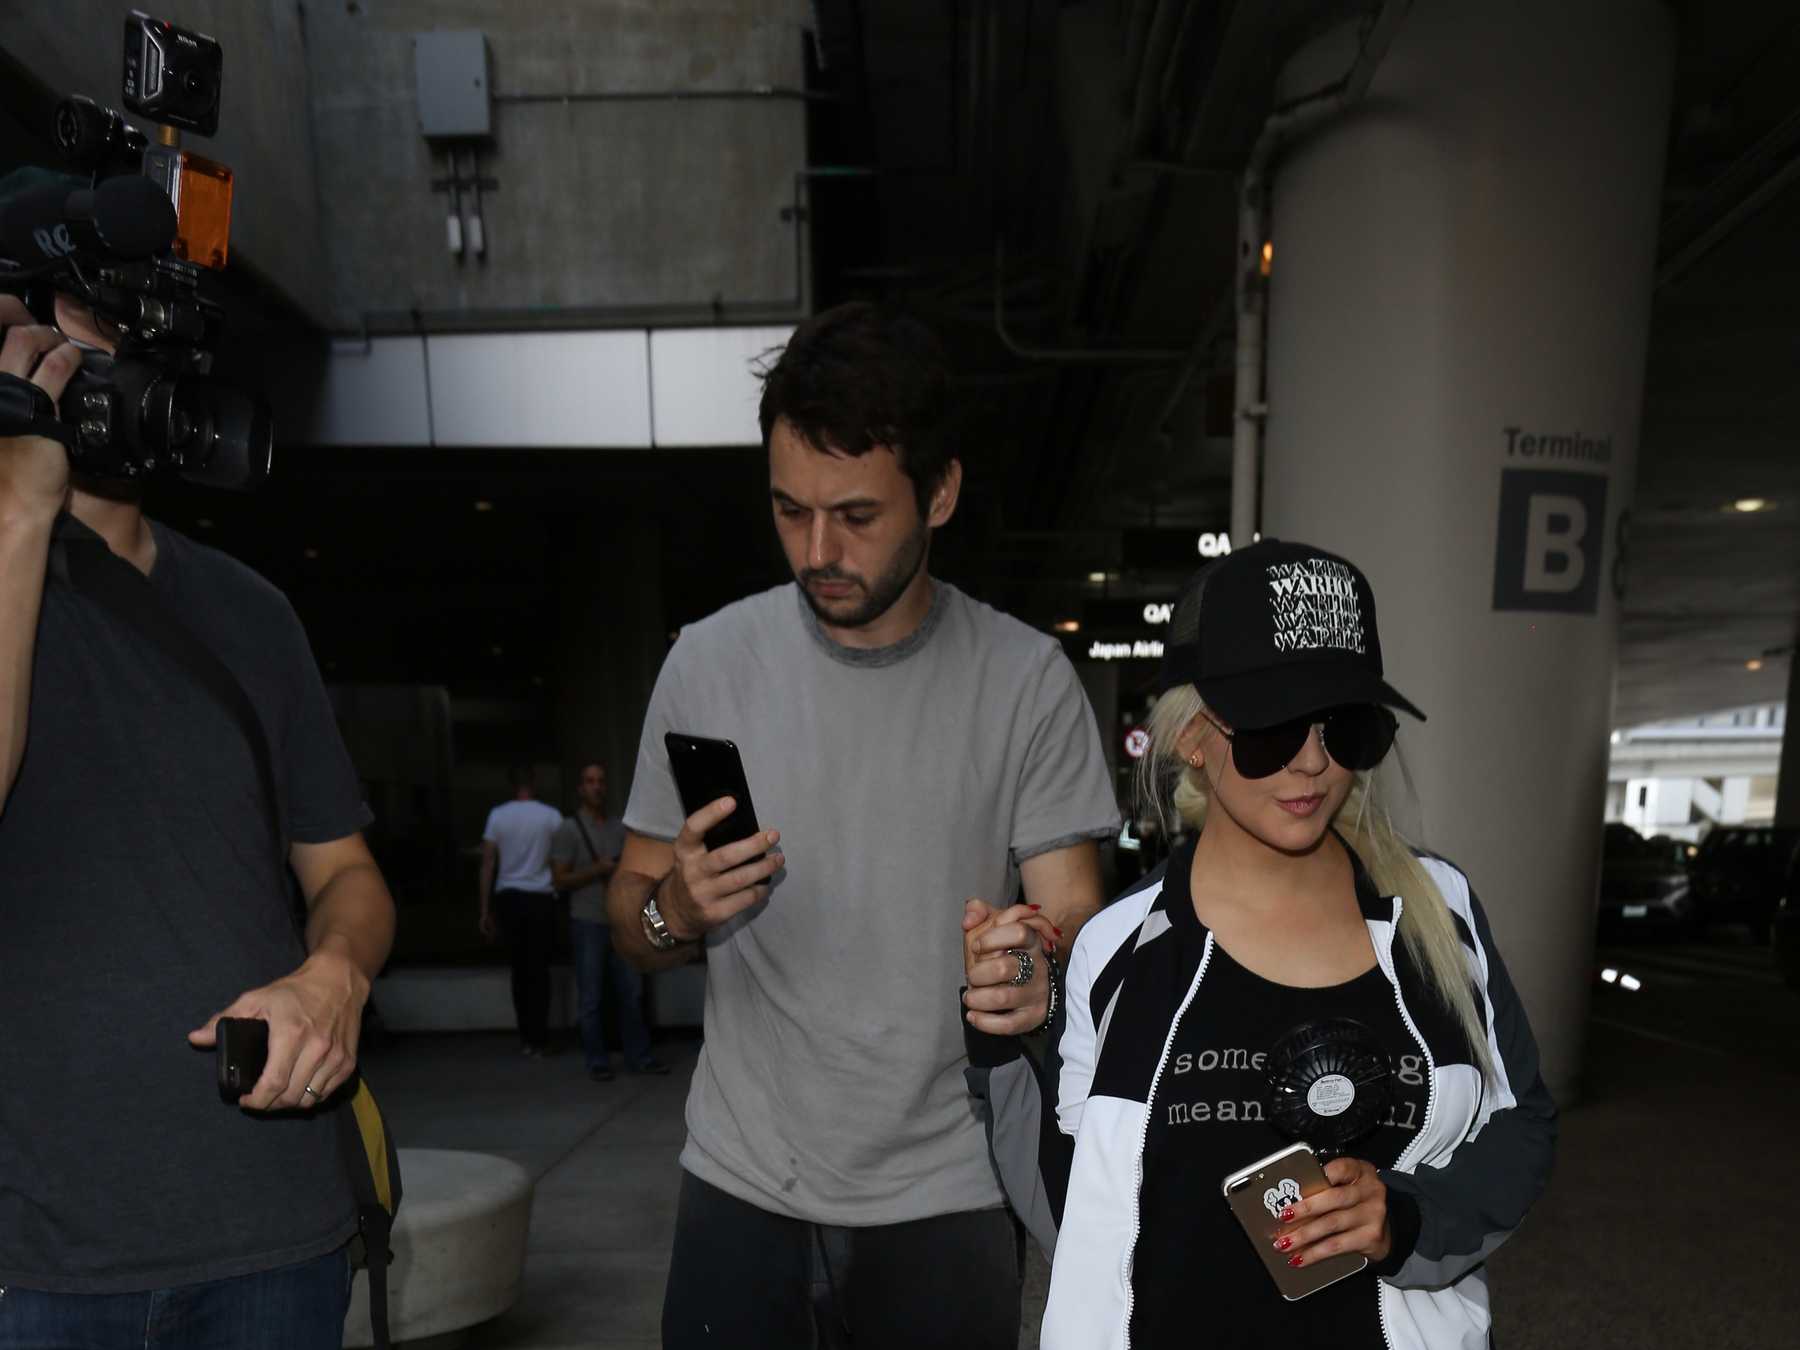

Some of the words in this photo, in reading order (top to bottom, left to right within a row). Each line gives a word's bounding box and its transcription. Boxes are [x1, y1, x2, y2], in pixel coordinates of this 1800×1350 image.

[1502, 427, 1612, 462] Terminal
[1523, 494, 1588, 591] B
[1269, 576, 1358, 601] WARHOL
